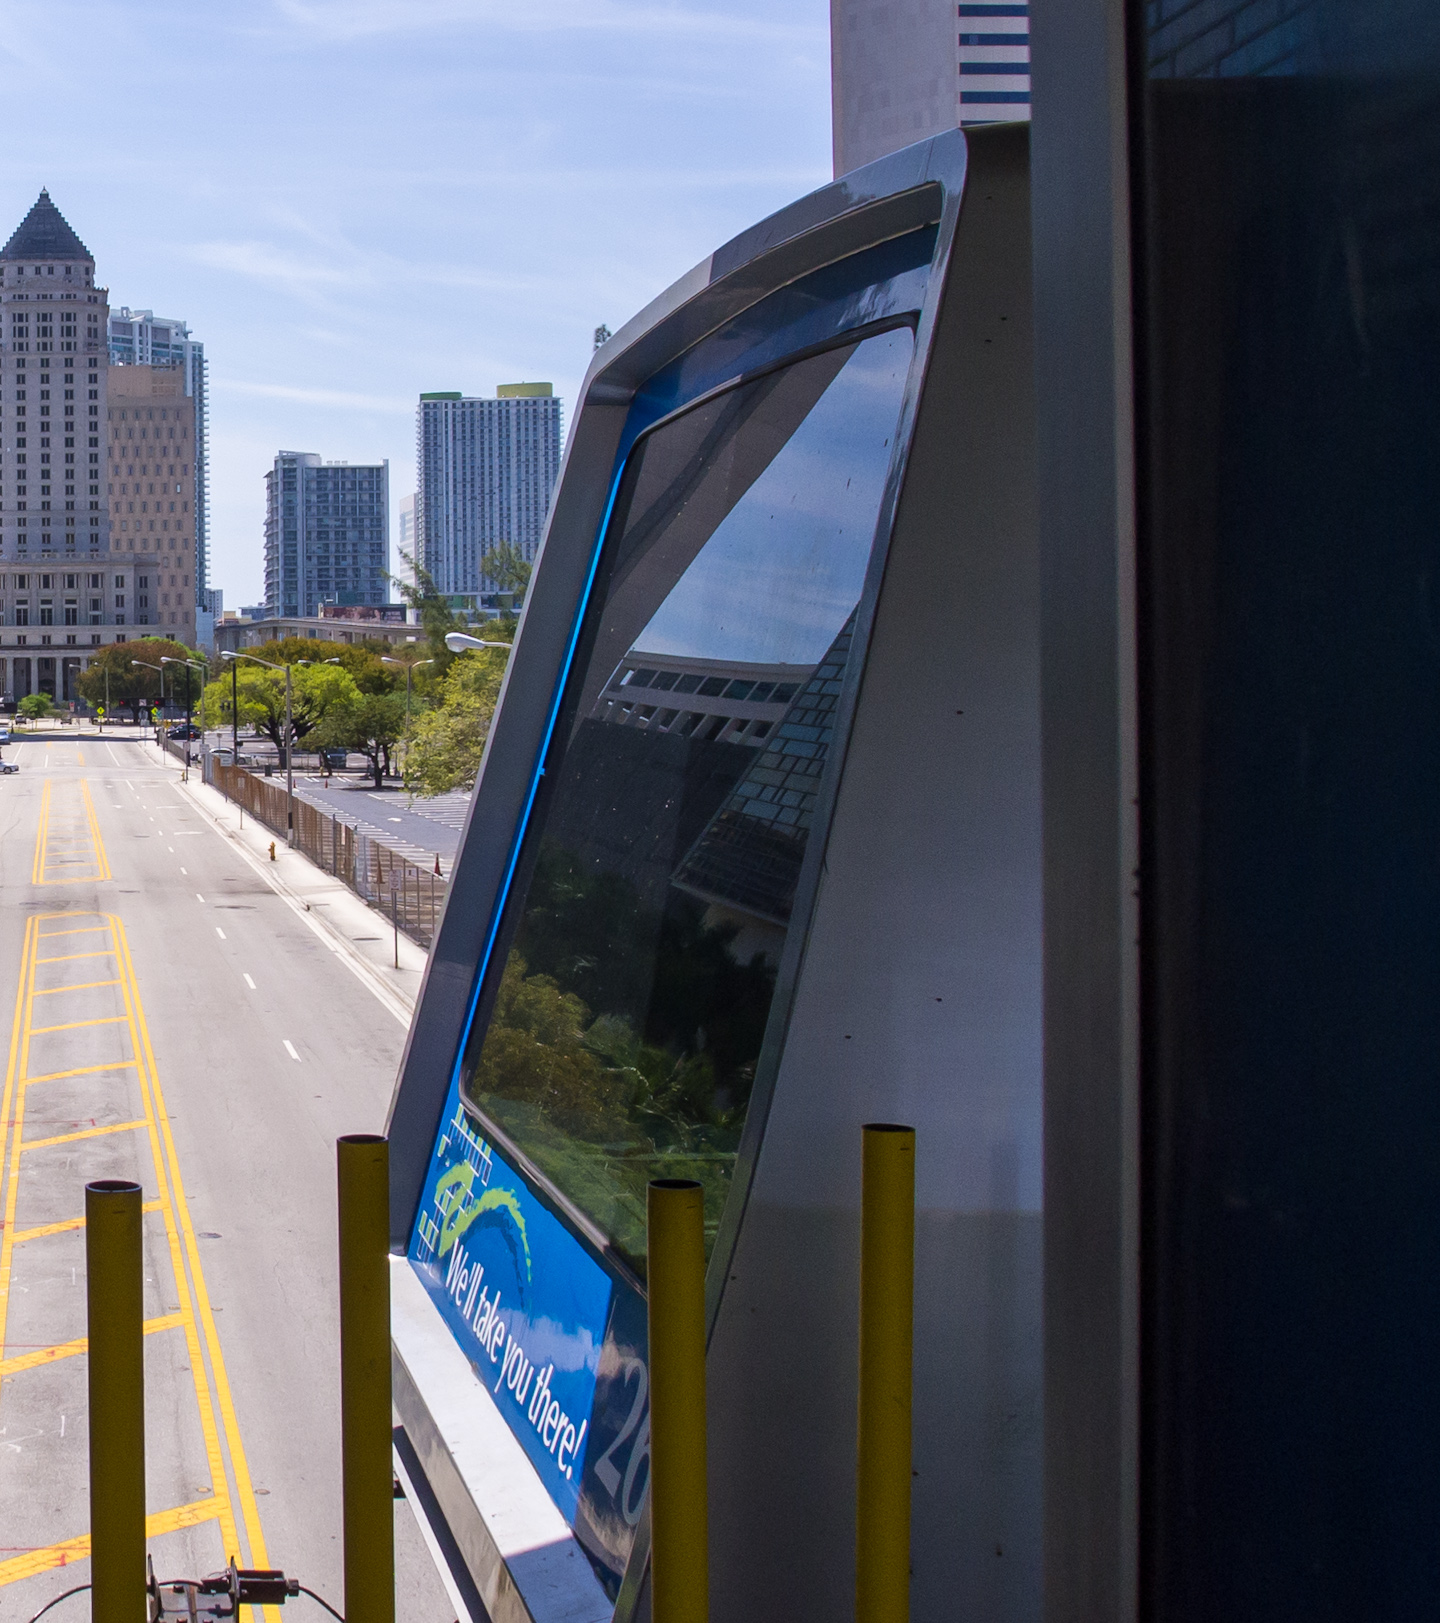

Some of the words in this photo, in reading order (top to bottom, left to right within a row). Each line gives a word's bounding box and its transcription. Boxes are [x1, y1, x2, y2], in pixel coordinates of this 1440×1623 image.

[445, 1236, 484, 1320] We'll
[473, 1290, 505, 1362] take
[494, 1335, 534, 1405] you
[528, 1363, 588, 1479] there!
